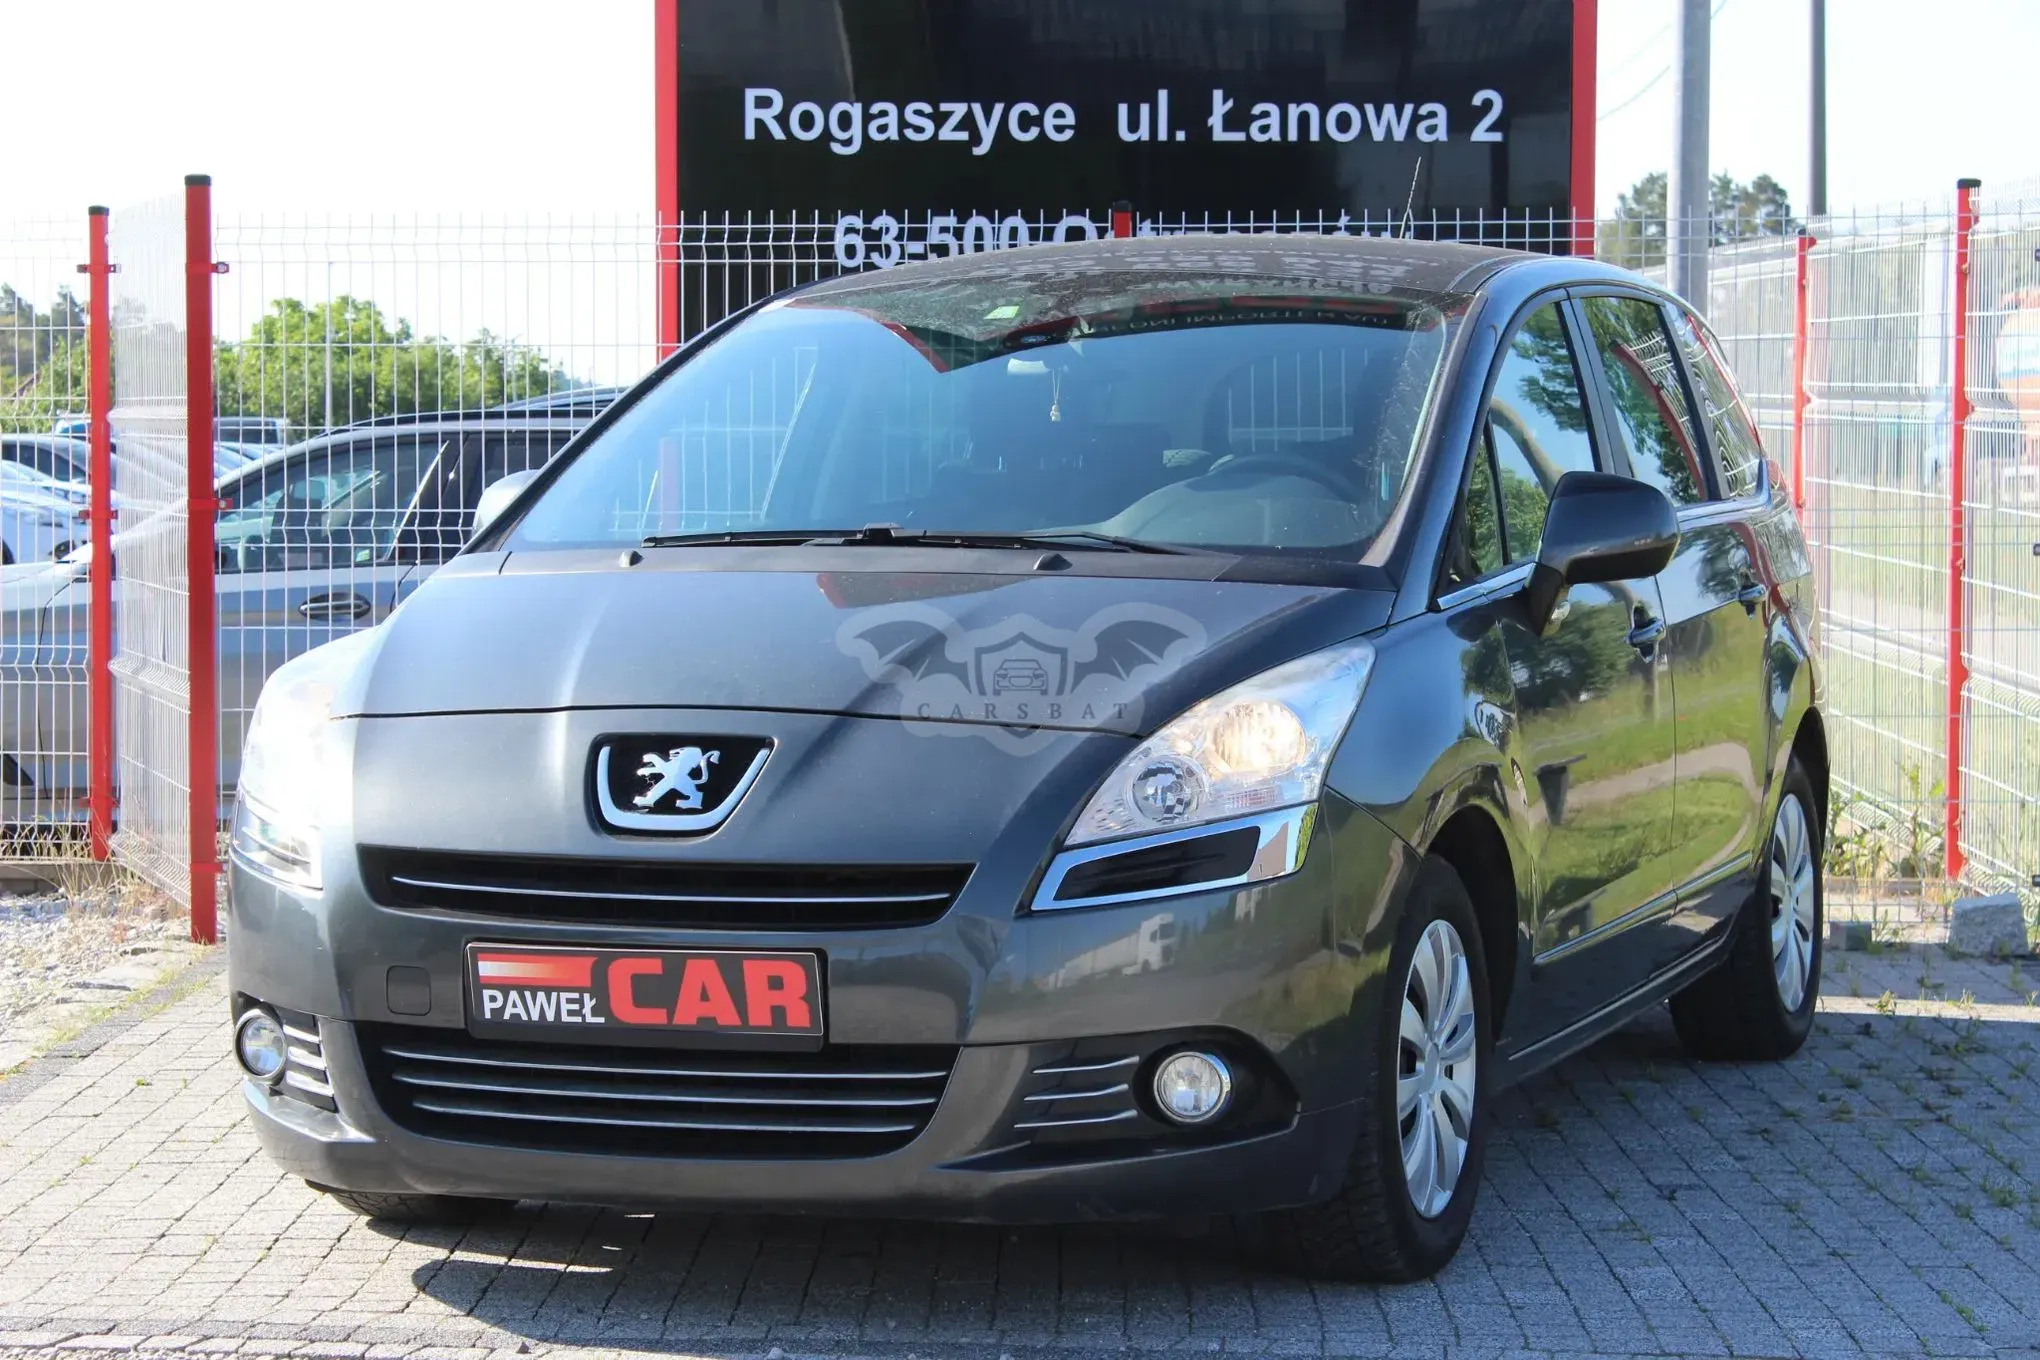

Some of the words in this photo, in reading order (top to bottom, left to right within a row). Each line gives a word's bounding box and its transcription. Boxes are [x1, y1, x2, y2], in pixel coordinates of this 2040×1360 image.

[744, 87, 1076, 155] Rogaszyce
[1116, 88, 1187, 142] ul.
[1207, 88, 1449, 142] Łanowa
[1469, 88, 1504, 142] 2
[481, 988, 605, 1024] PAWEŁ
[607, 957, 812, 1028] CAR
